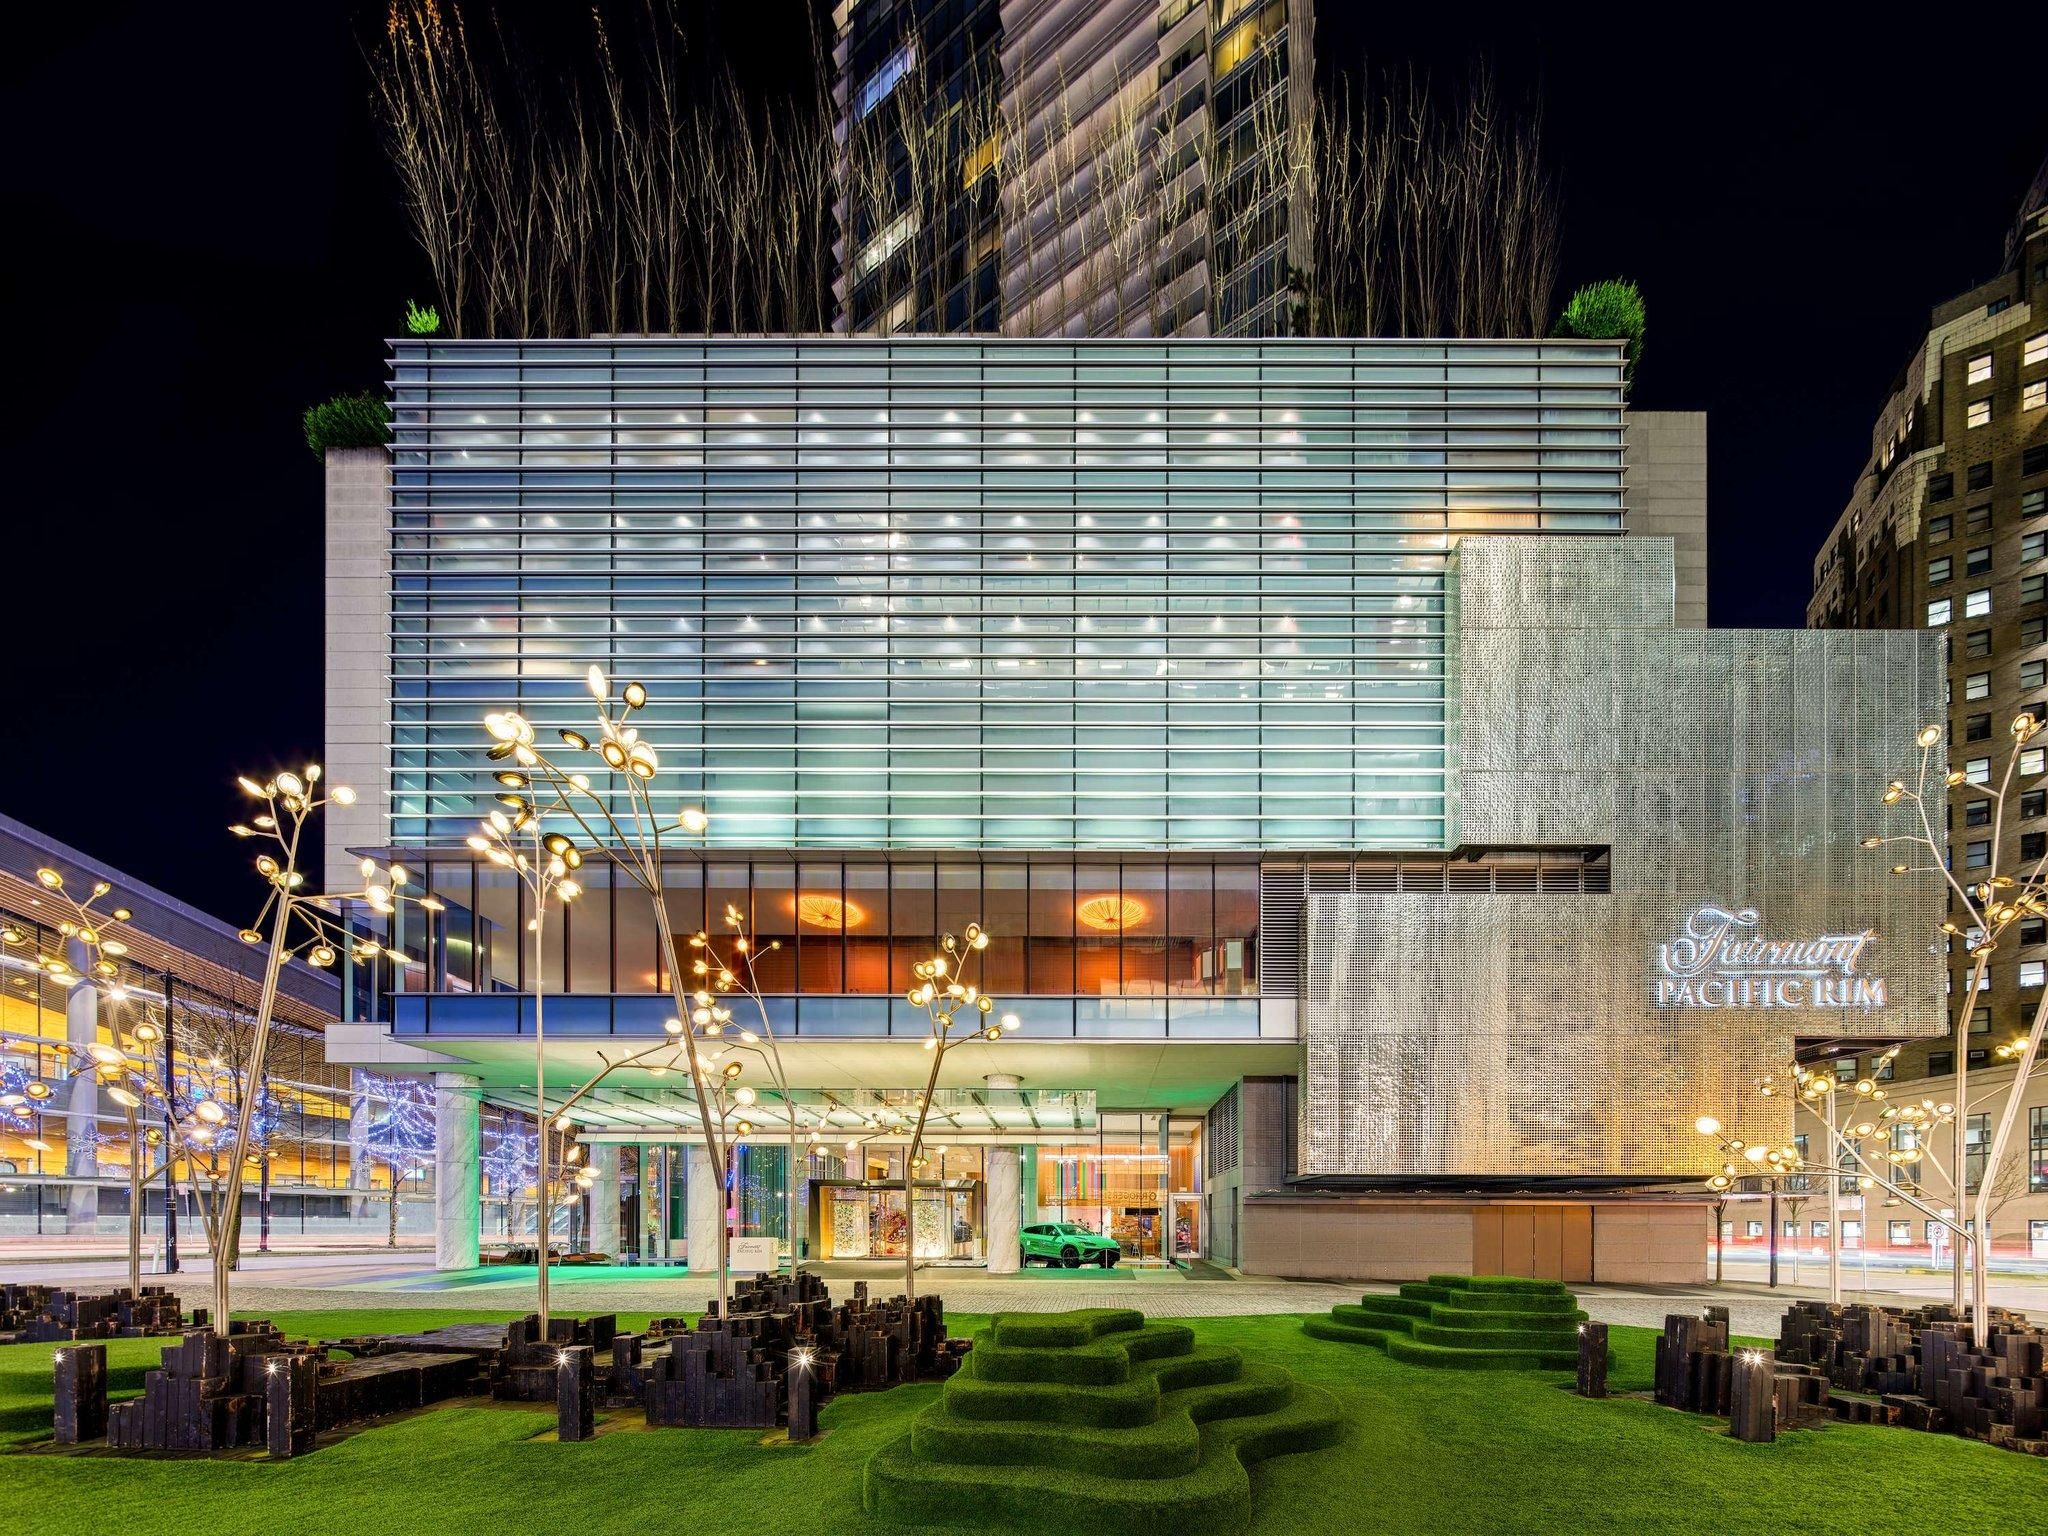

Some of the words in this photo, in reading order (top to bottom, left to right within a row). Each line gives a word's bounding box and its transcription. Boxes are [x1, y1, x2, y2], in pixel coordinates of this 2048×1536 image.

[1663, 904, 1880, 977] Fairmont
[1658, 977, 1802, 1006] PACIFIC
[1816, 977, 1888, 1006] RIM
